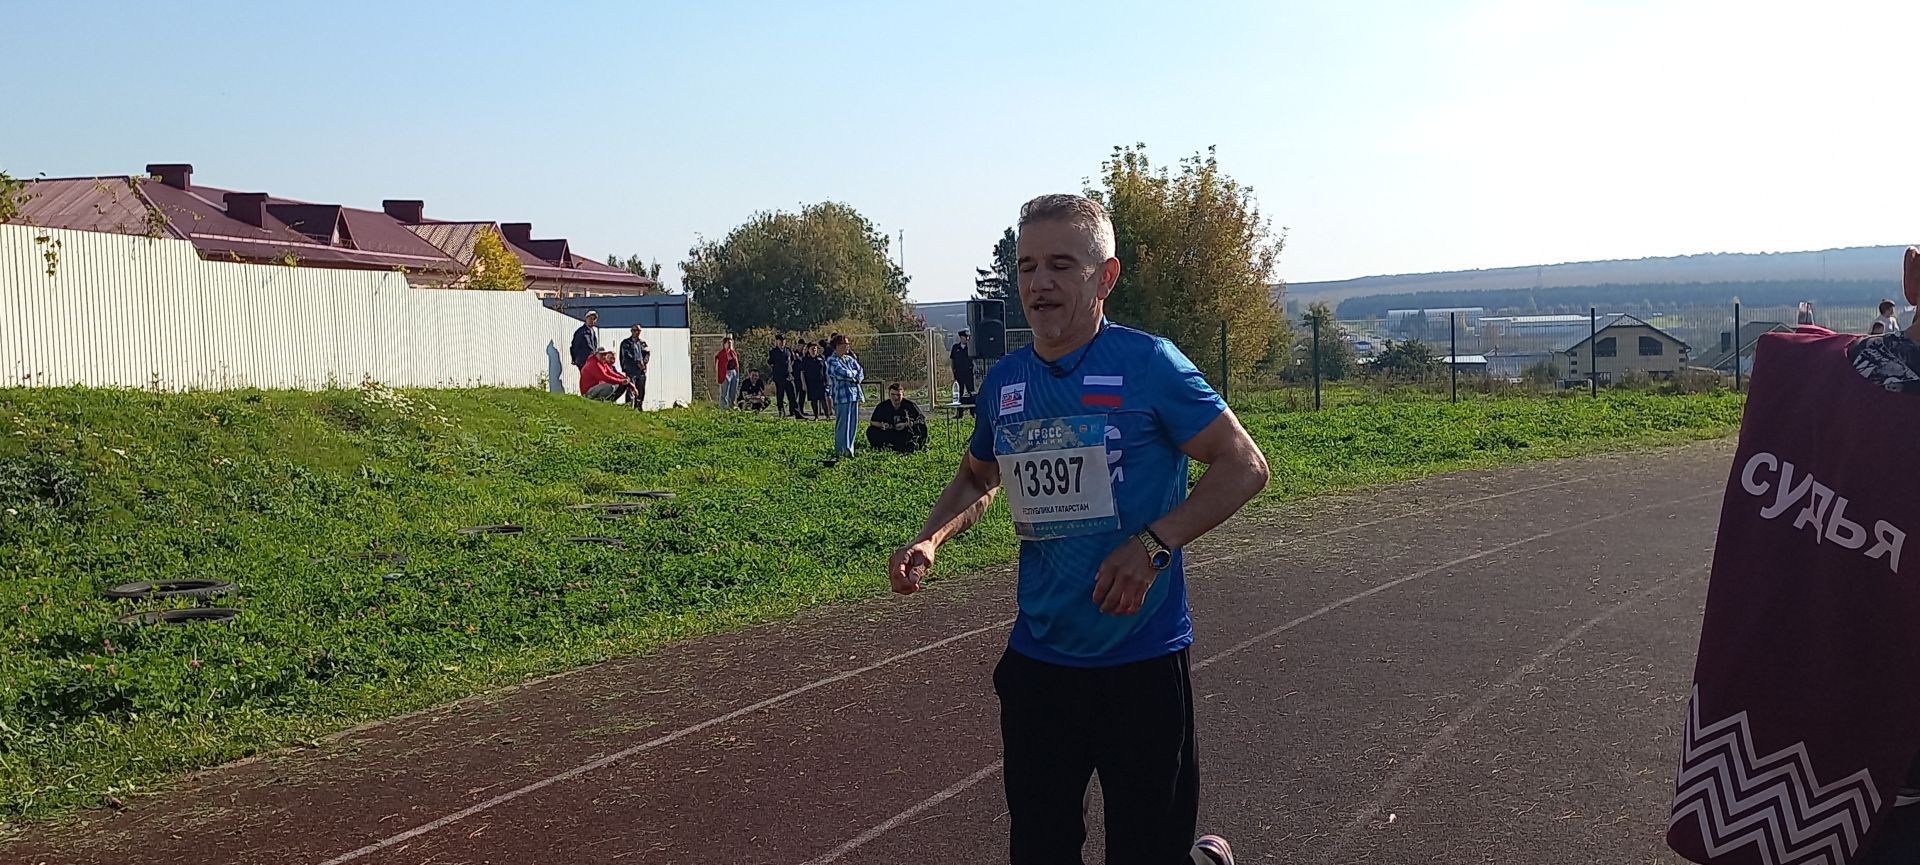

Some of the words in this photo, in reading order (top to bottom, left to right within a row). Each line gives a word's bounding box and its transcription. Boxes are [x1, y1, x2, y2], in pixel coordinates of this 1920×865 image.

[1028, 426, 1063, 441] КРОСС
[1013, 456, 1084, 498] 13397
[1054, 502, 1090, 514] ТАТАРСТАН
